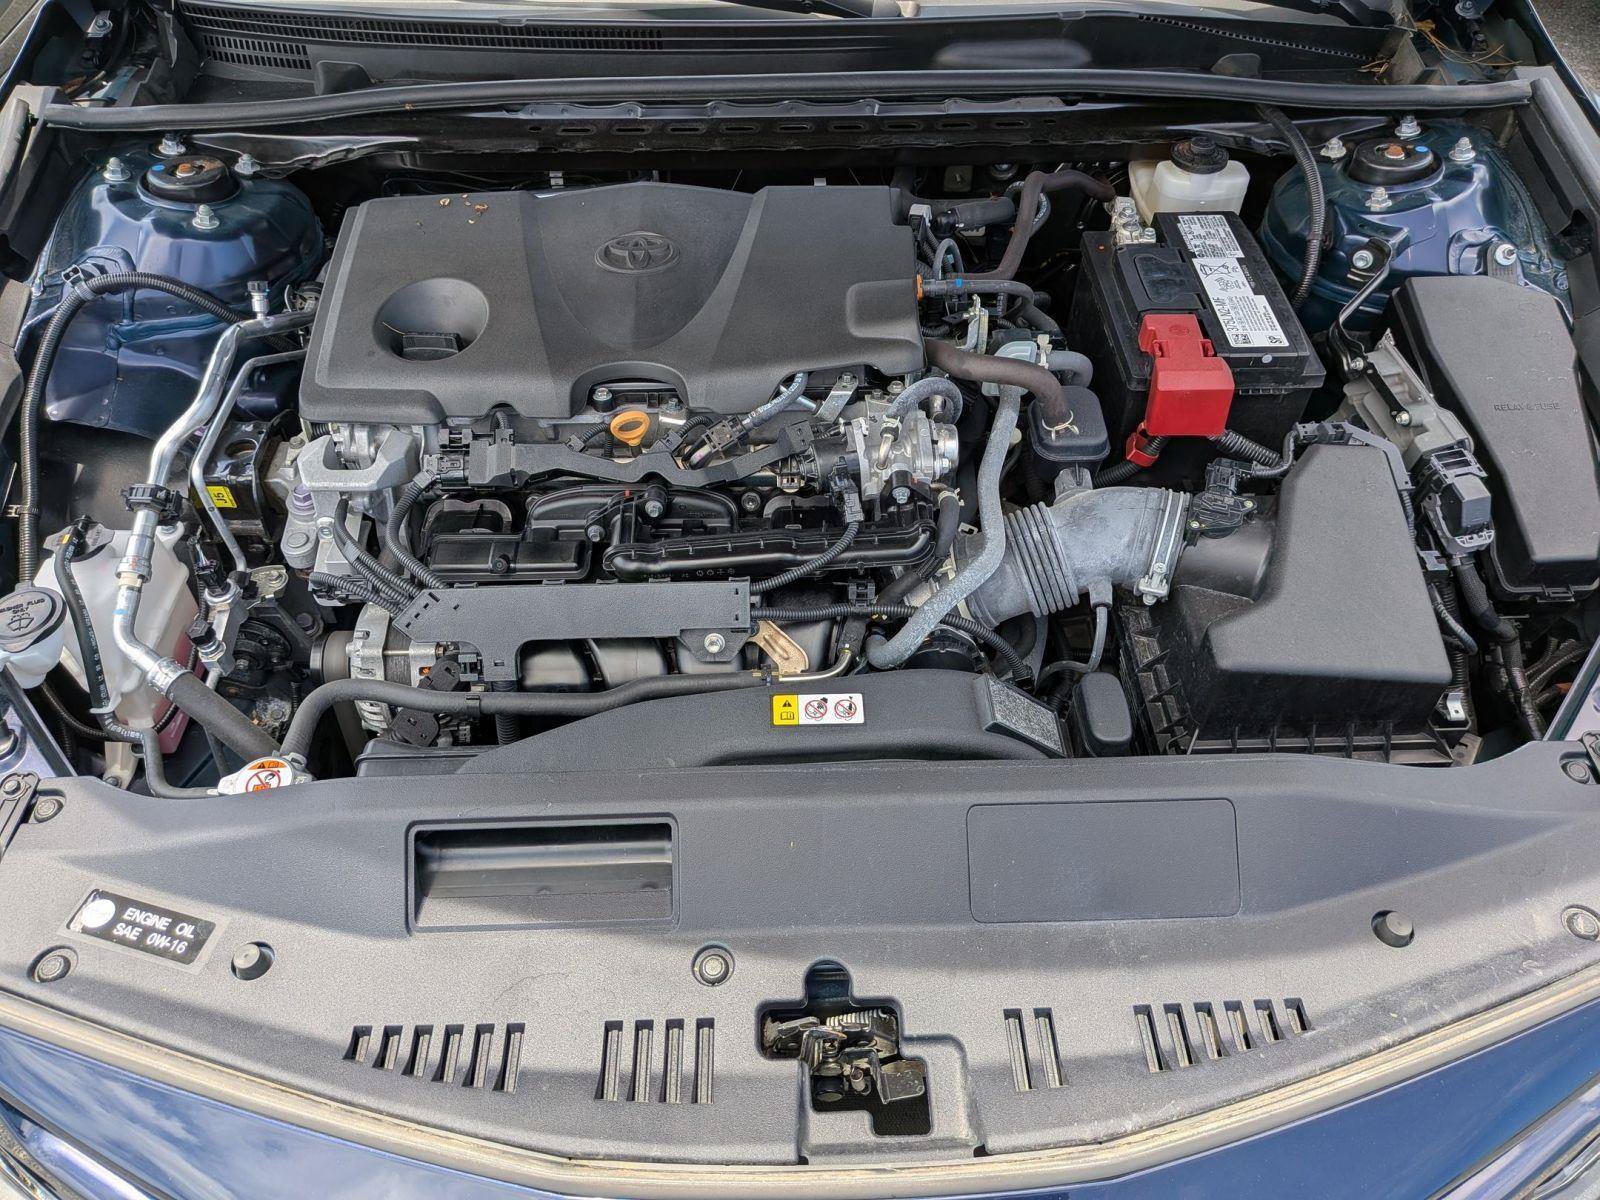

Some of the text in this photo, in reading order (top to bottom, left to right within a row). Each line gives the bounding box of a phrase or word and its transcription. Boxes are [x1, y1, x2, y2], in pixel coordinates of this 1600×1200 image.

[1493, 402, 1524, 411] RELAY
[1534, 401, 1561, 411] FUSE
[0, 598, 45, 612] ASHER FLUID
[12, 606, 29, 614] ONLY
[122, 907, 196, 939] ENGINE OIL
[112, 922, 188, 954] SAE 0W-16
